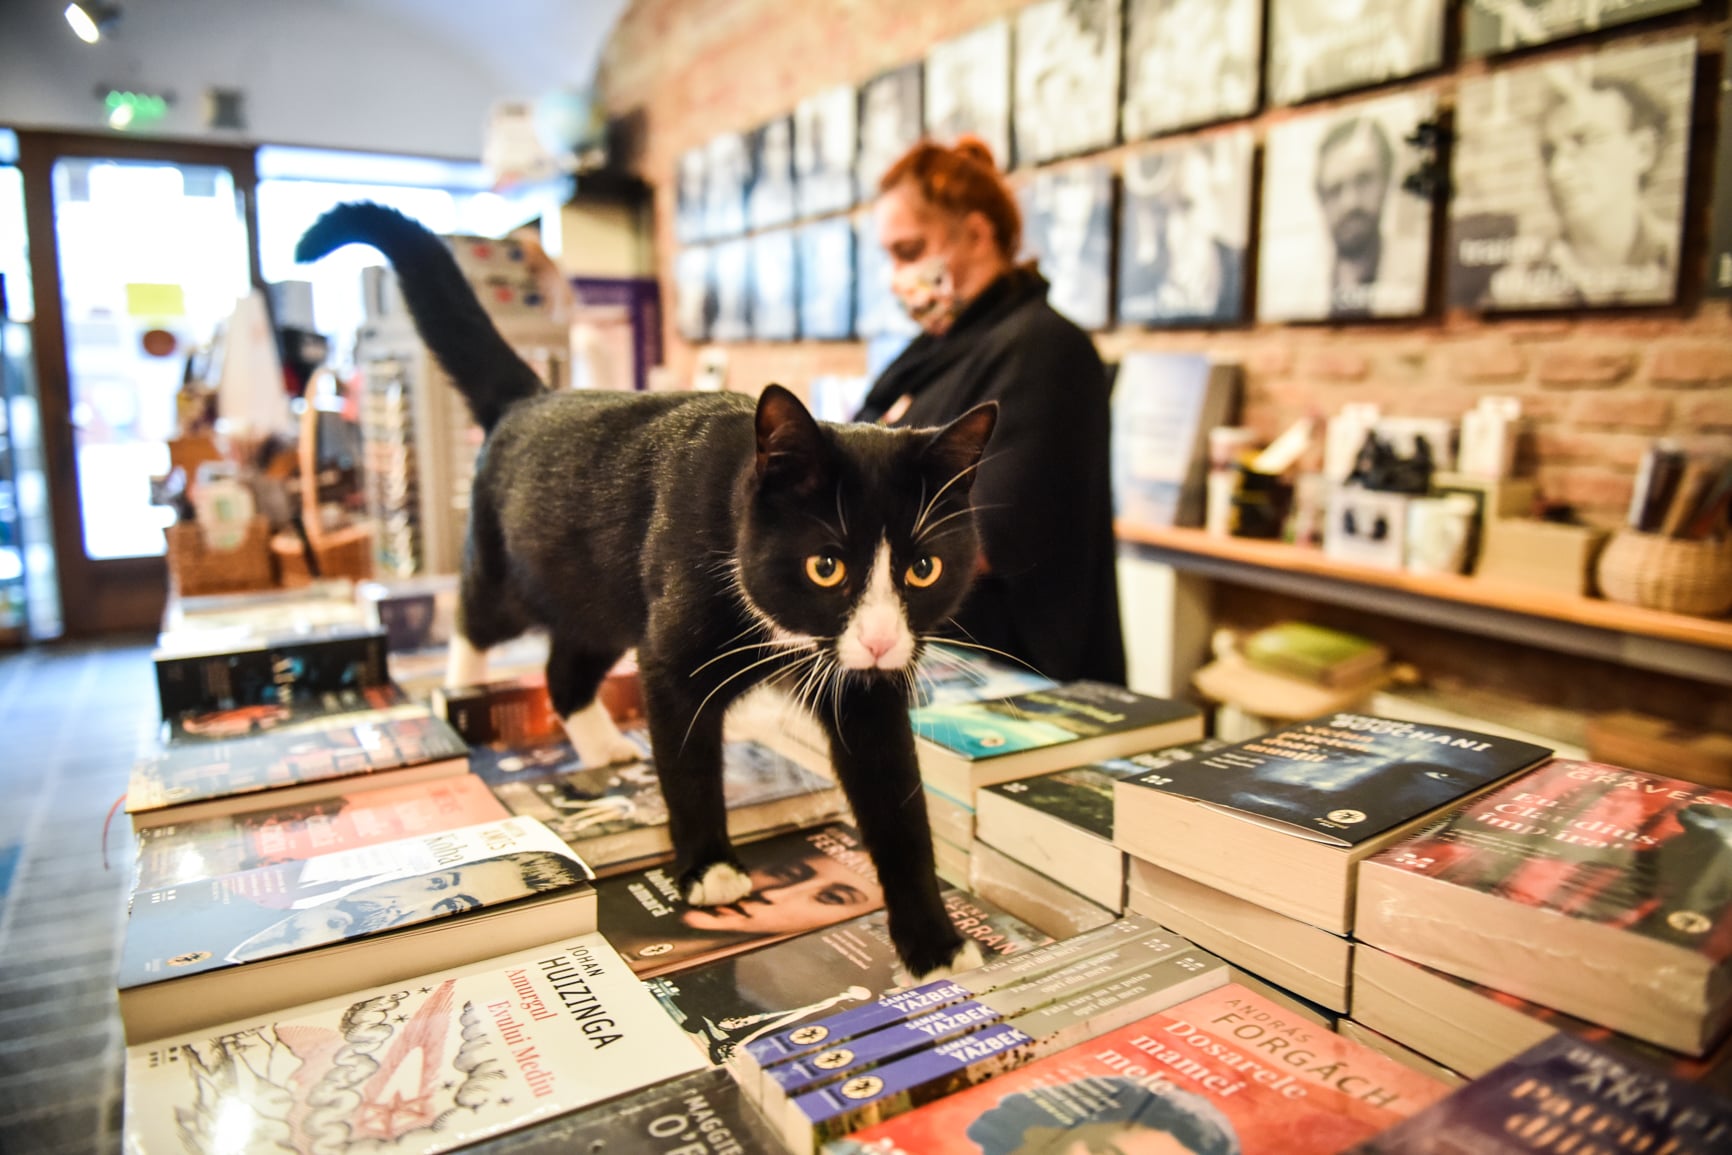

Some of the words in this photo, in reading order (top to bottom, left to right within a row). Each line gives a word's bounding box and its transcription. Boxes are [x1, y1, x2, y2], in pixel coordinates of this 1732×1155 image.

[1566, 770, 1717, 806] GRAVES
[566, 945, 605, 977] JOHAN
[504, 968, 559, 1022] Amurgul
[537, 956, 624, 1050] HUIZINGA
[878, 990, 920, 1008] SAMAR
[891, 983, 967, 1013] YAZBEK
[905, 1011, 947, 1031] SAMAR
[918, 1004, 997, 1036] YAZBEK
[1226, 998, 1311, 1044] ANDRÁS
[487, 1000, 533, 1046] Evului
[512, 1046, 556, 1099] Mediu
[934, 1036, 979, 1056] SAMAR
[950, 1028, 1029, 1062] YAZBEK
[1128, 1033, 1247, 1098] mamei
[1163, 1019, 1308, 1100] Dosarele
[1211, 1013, 1400, 1108] FORGÁCH
[1095, 1047, 1175, 1096] mele
